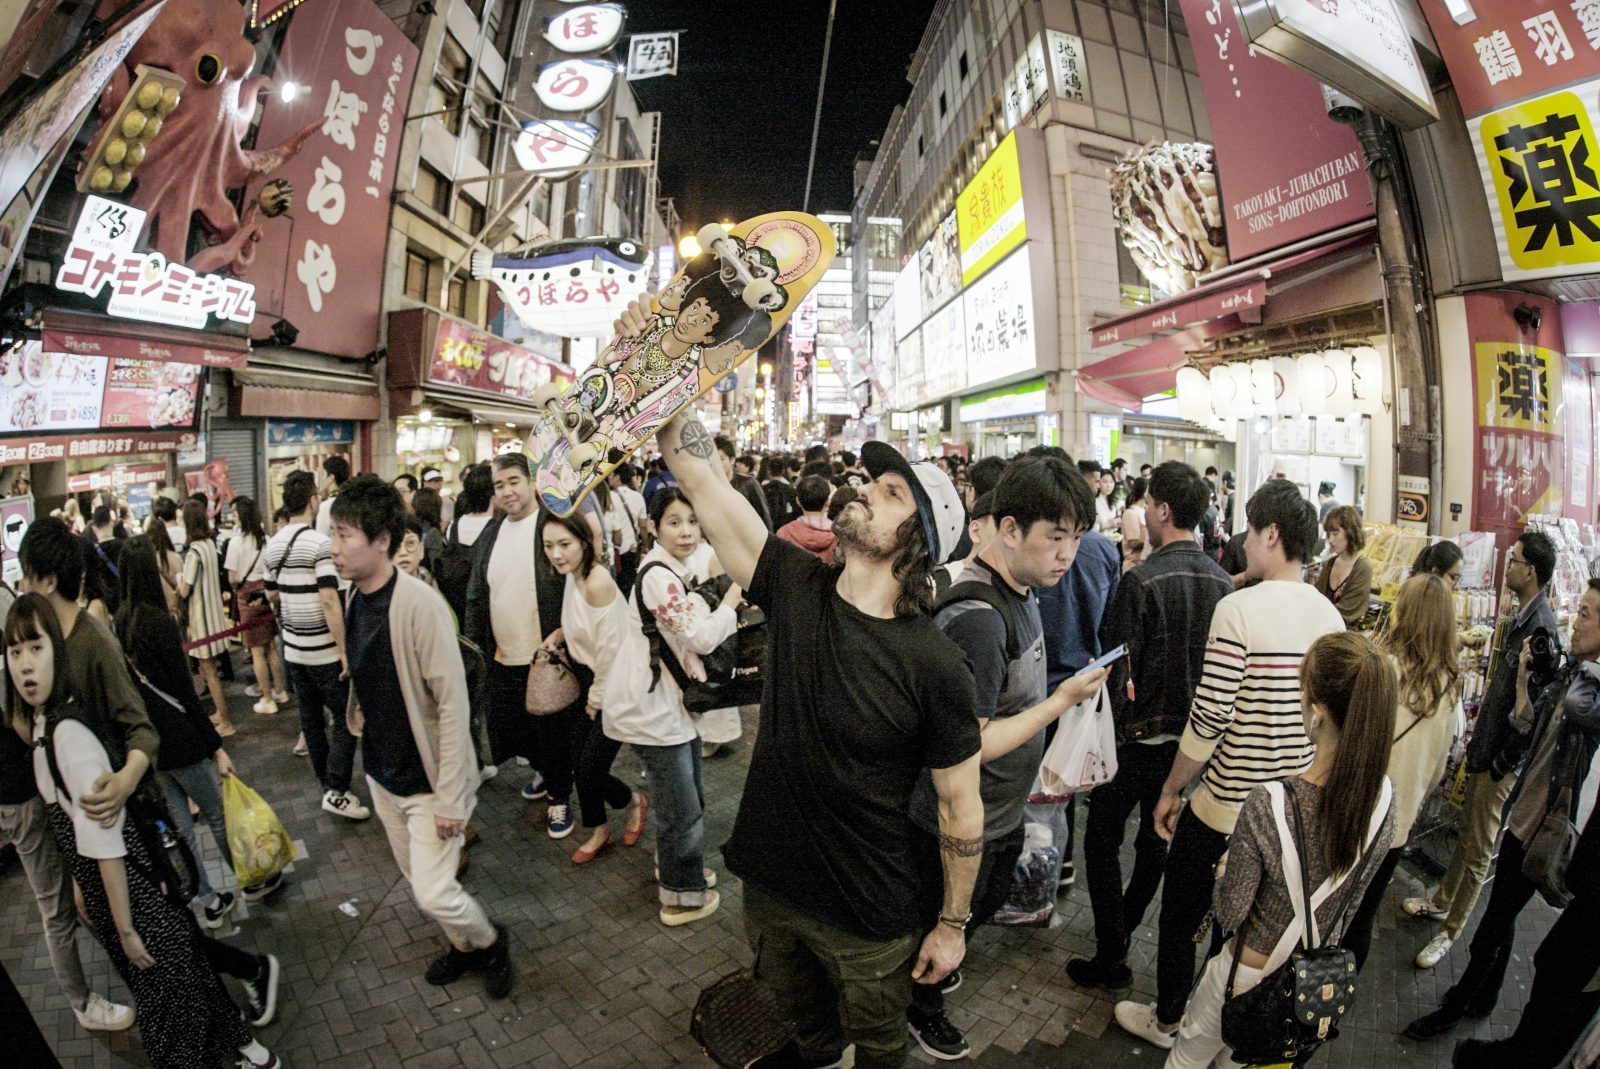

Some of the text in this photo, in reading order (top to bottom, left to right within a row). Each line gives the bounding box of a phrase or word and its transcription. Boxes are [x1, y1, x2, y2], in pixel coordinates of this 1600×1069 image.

[1233, 152, 1360, 220] TAKOYAKI-JUHACHIBAN
[1249, 180, 1349, 234] SONS-DOHTONBORI
[1494, 113, 1600, 253] 薬
[1497, 351, 1549, 424] 薬
